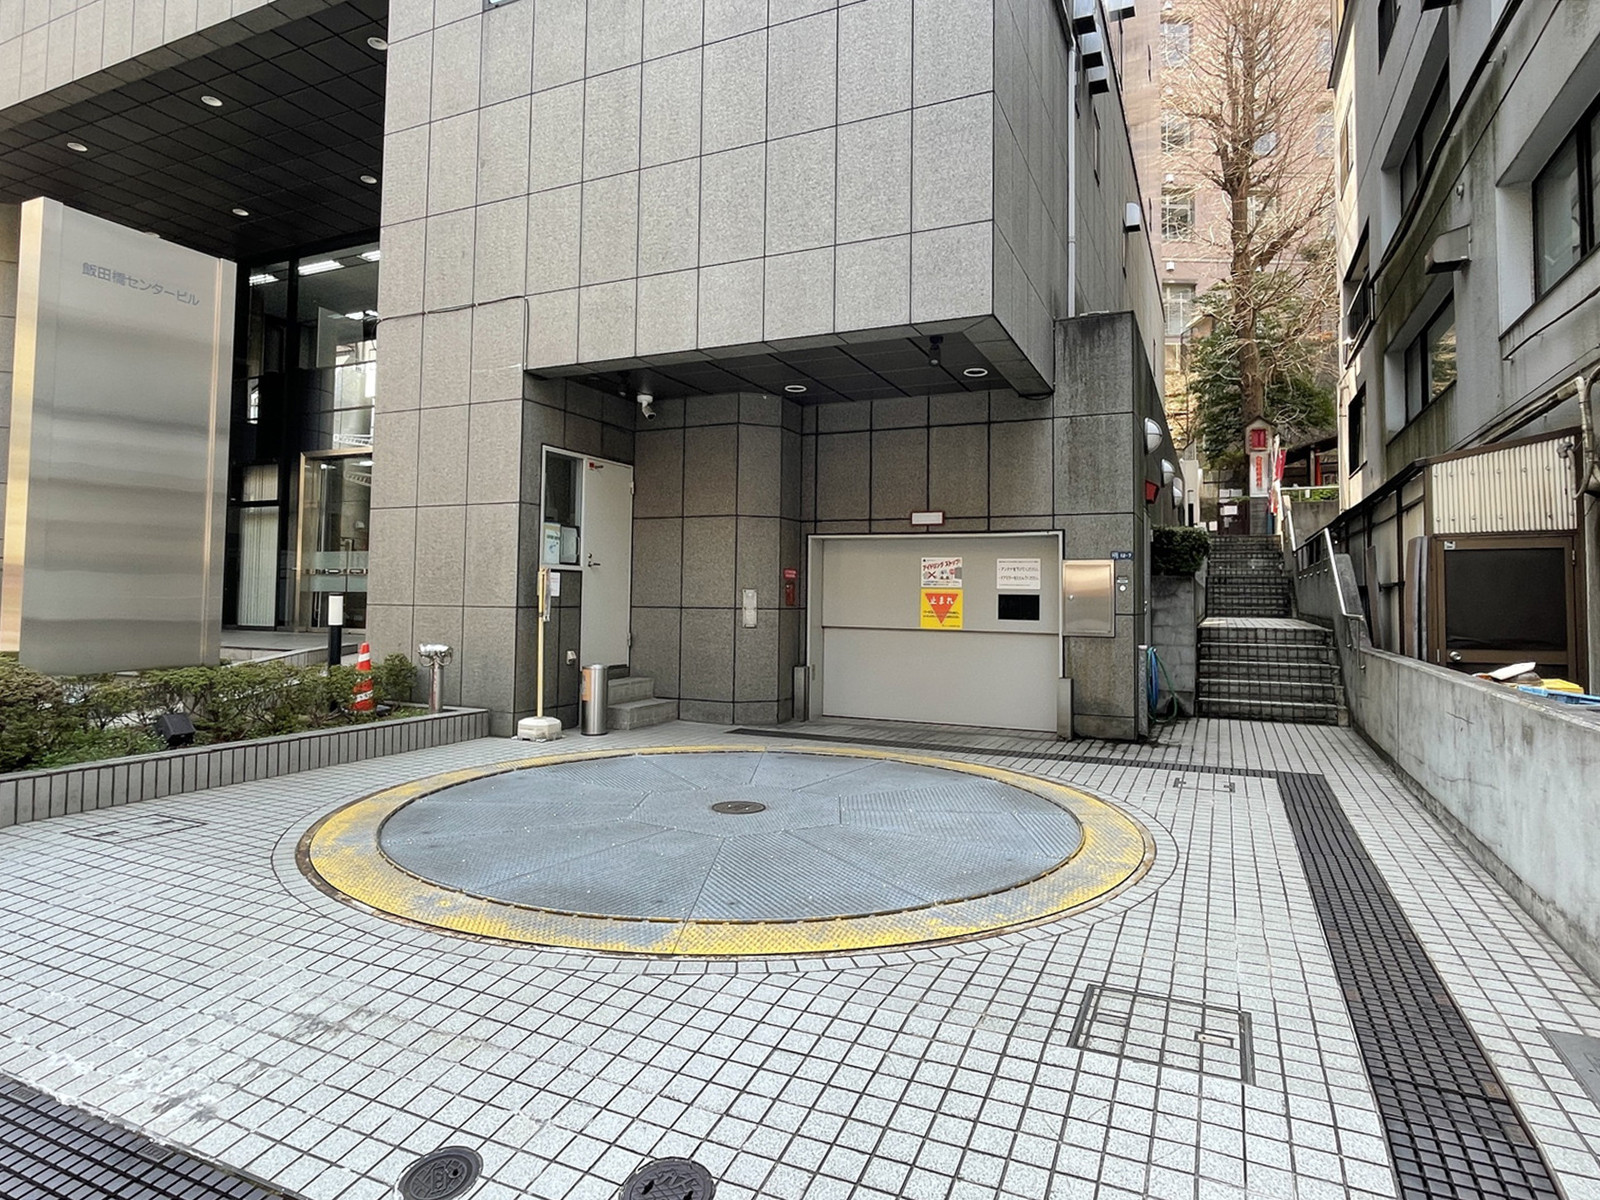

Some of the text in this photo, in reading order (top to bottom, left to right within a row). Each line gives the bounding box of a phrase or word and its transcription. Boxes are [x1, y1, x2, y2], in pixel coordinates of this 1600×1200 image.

[82, 262, 200, 306] 飯田橋センタービル
[929, 595, 954, 605] 止まれ
